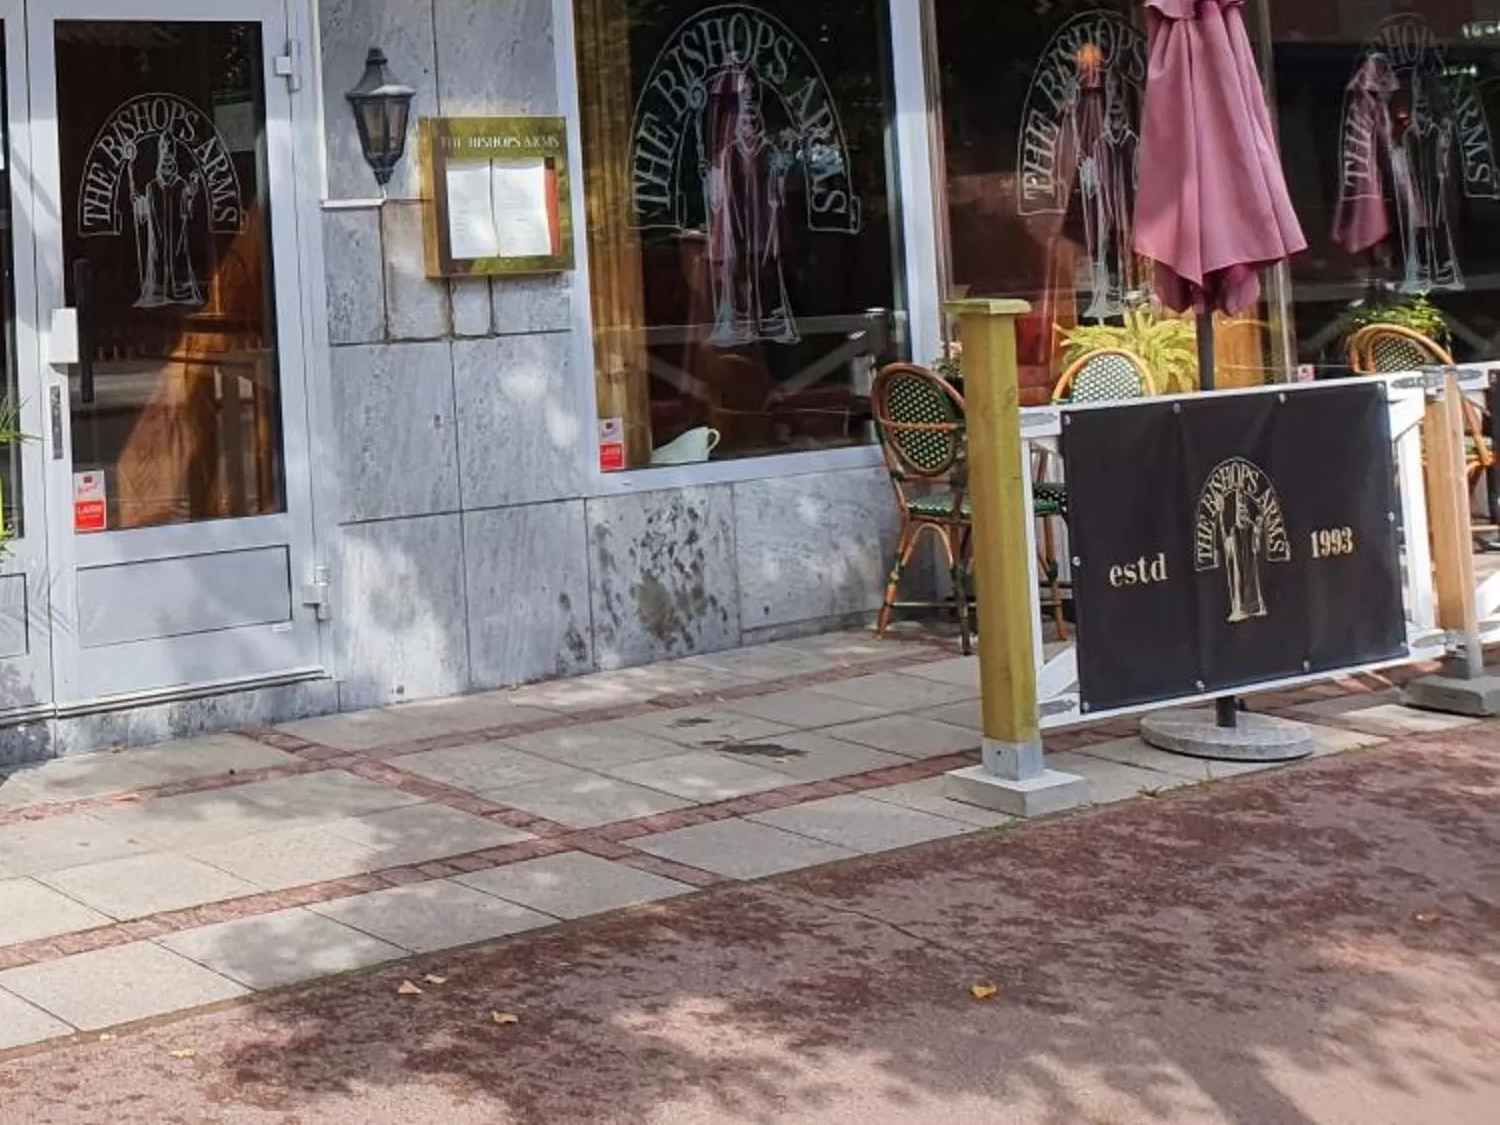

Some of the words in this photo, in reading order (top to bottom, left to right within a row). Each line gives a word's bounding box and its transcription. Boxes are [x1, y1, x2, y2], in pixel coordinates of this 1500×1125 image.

[651, 12, 794, 118] BISHOPS
[98, 98, 199, 167] BISHOPS
[523, 135, 560, 149] ARMS
[1023, 107, 1061, 201] THE
[83, 162, 118, 225] THE
[193, 136, 238, 222] ARMS
[633, 123, 679, 216] THE
[1202, 462, 1259, 517] BISHOPS
[1261, 487, 1285, 552] ARMS
[1108, 553, 1168, 588] estd
[1197, 515, 1216, 564] THE
[1309, 526, 1354, 559] 1993
